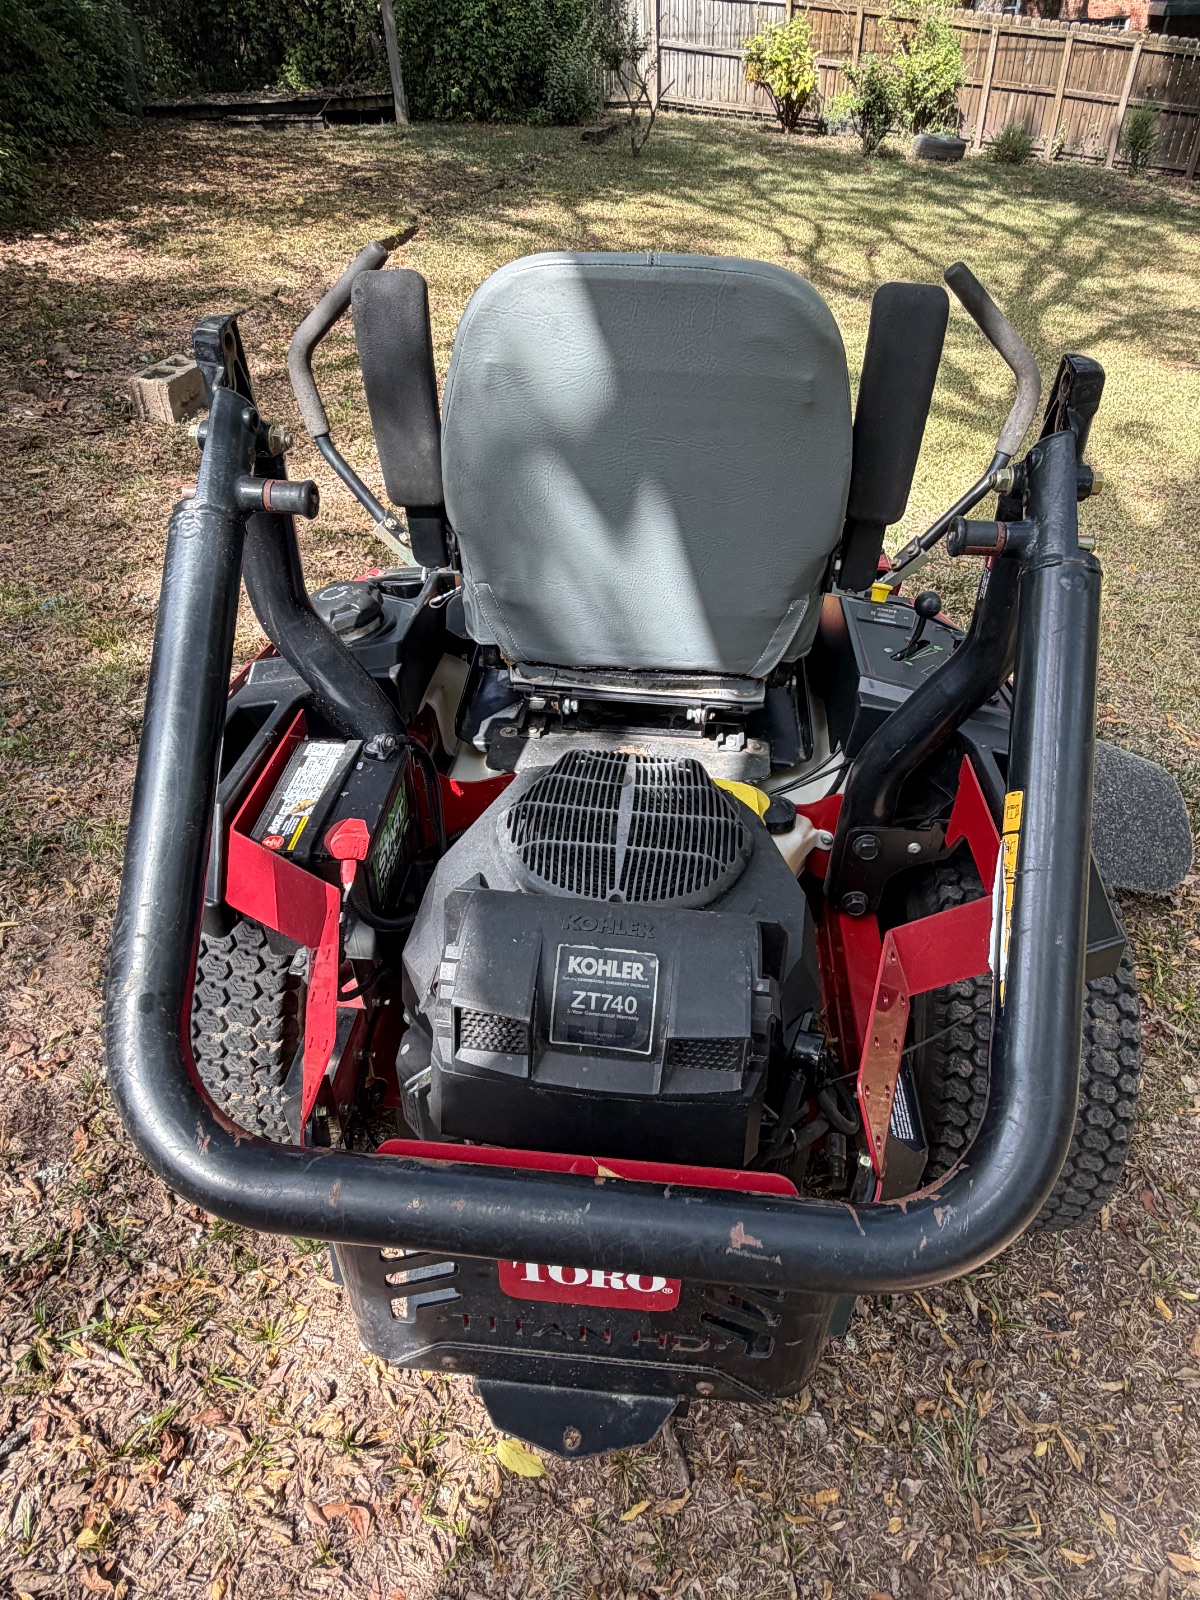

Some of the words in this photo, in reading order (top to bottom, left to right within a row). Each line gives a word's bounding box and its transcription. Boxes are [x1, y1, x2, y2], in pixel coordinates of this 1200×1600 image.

[563, 915, 657, 939] KOHLER
[567, 955, 645, 981] KOHLER
[570, 990, 638, 1015] ZT740
[584, 1010, 616, 1019] Commercial
[616, 1013, 640, 1022] Warranty
